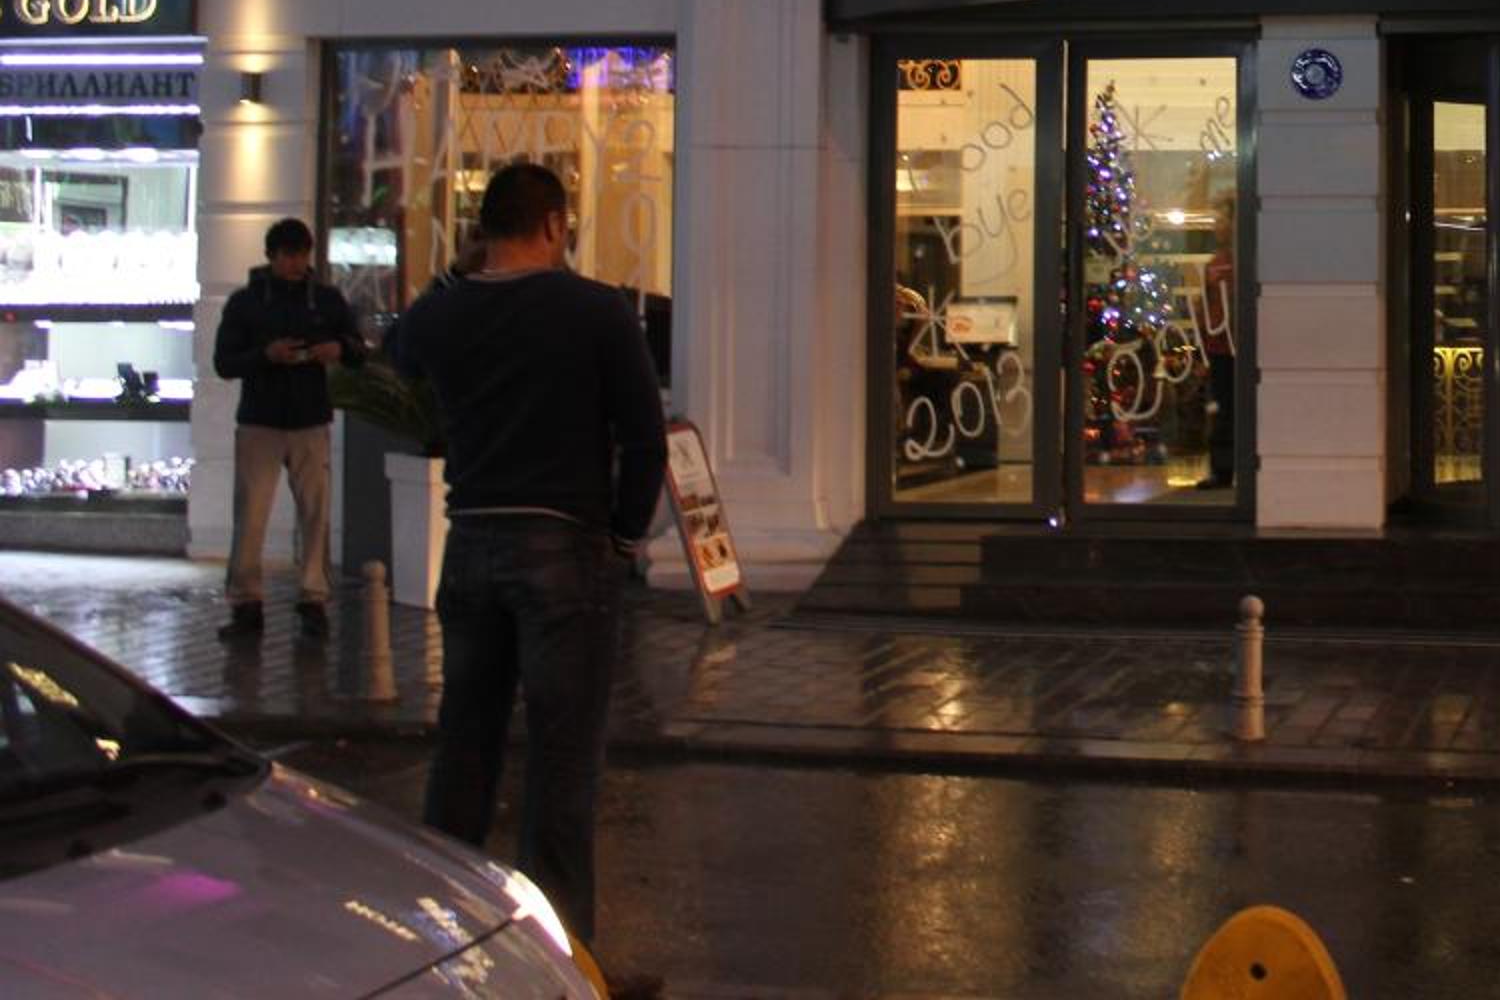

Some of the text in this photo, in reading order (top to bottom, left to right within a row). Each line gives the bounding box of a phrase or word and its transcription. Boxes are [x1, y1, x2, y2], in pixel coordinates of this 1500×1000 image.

[932, 188, 1032, 285] bye
[1100, 266, 1236, 421] 2014
[905, 350, 1034, 461] 2013
